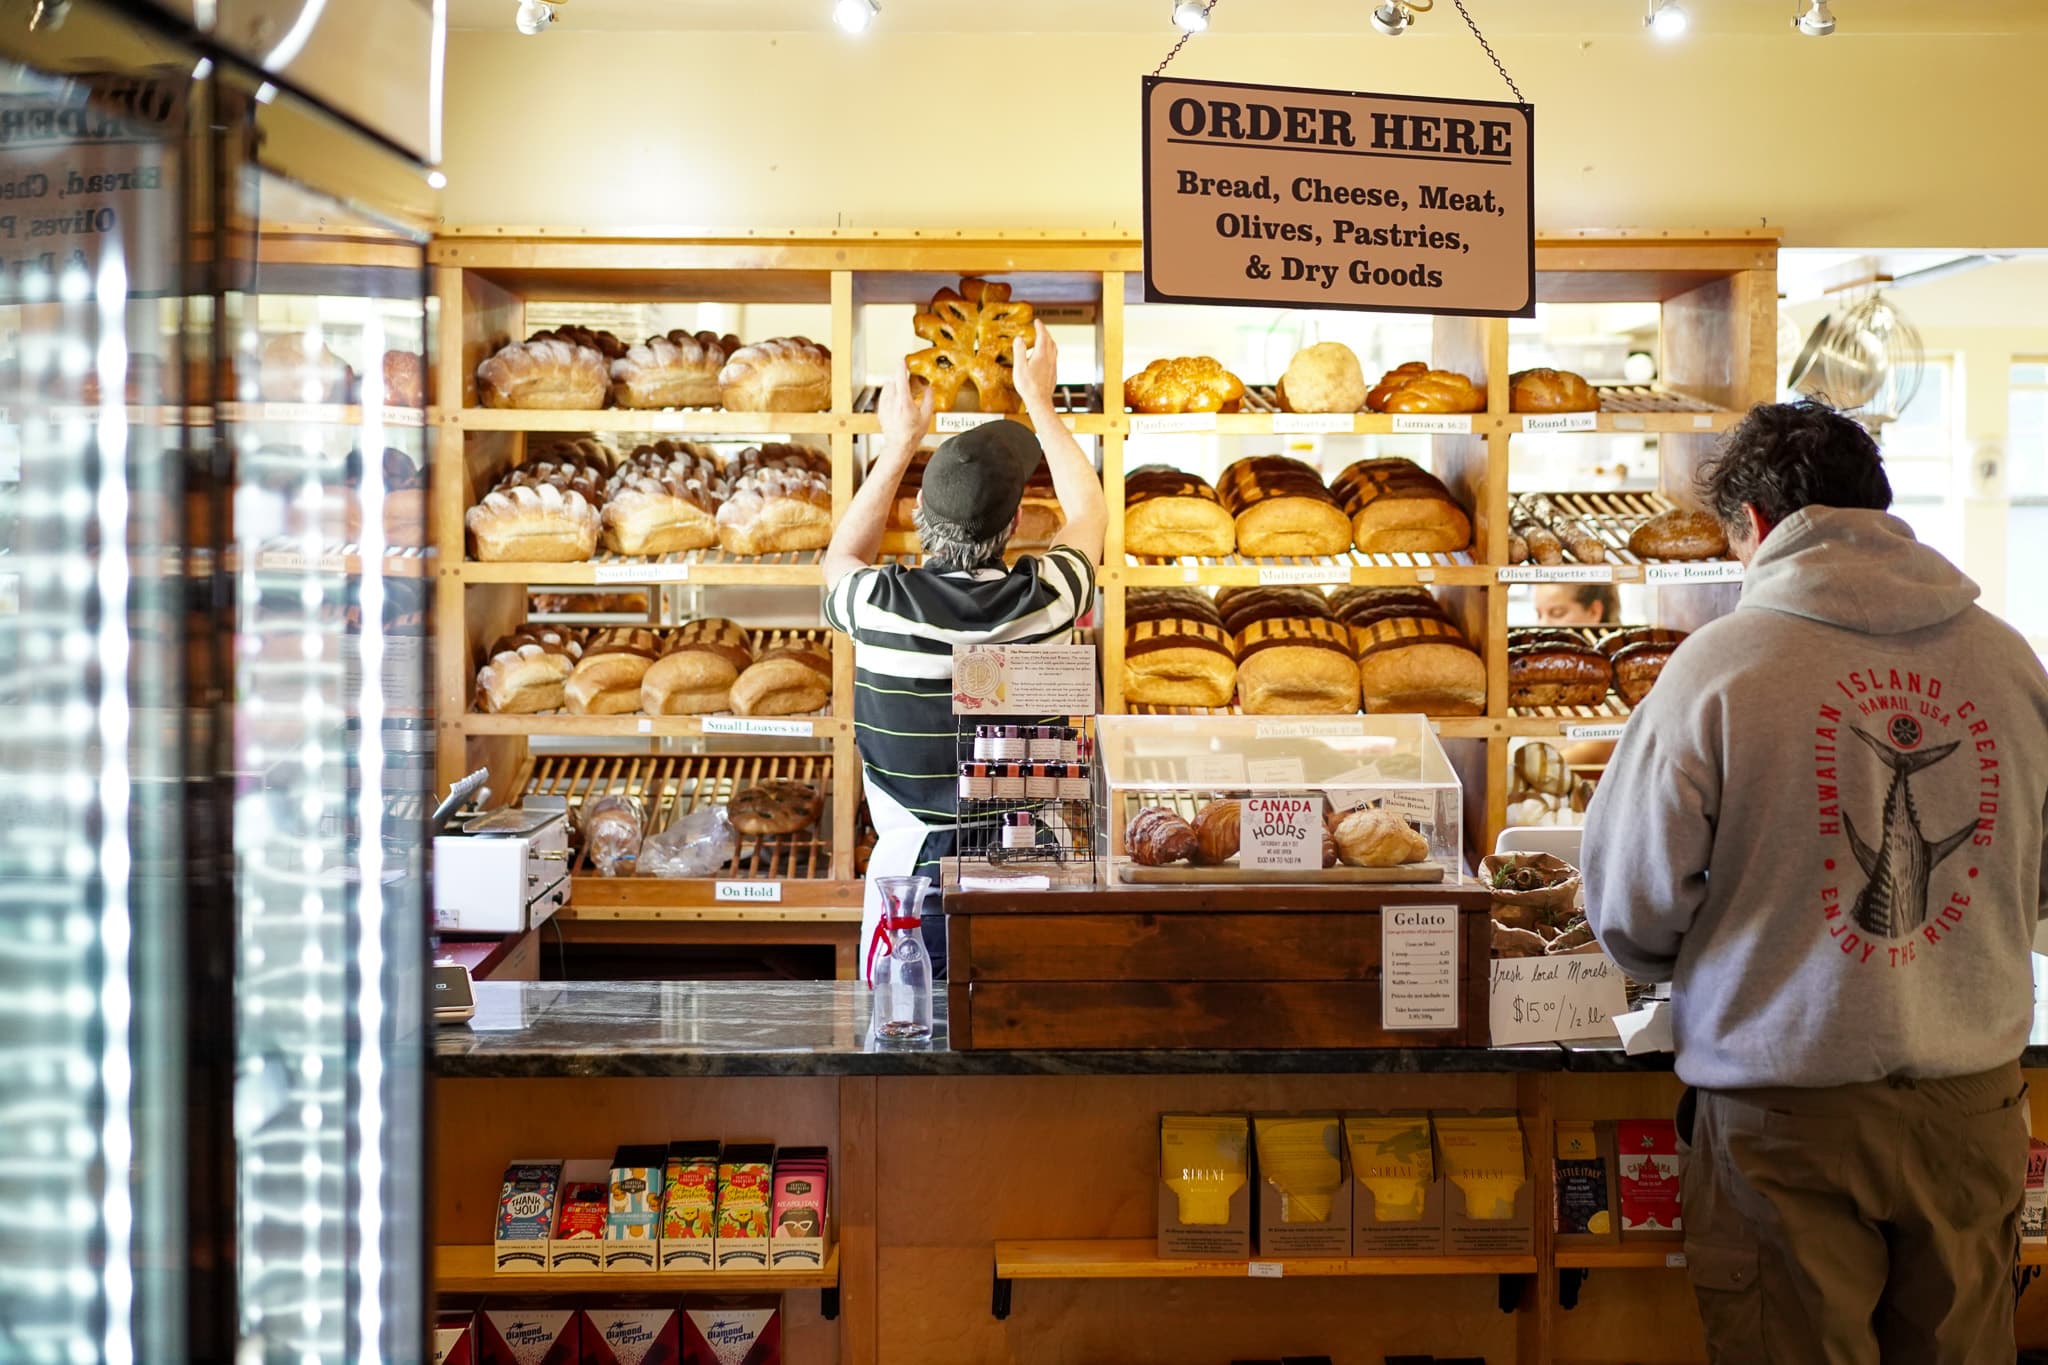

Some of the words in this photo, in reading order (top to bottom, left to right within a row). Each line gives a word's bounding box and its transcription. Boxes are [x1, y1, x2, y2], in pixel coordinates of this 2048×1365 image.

[1169, 98, 1356, 147] ORDER
[1370, 112, 1512, 157] HERE
[1176, 170, 1280, 204] Bread,
[1291, 177, 1408, 211] Cheese,
[1418, 185, 1505, 217] Meat,
[1216, 213, 1322, 246] Olives,
[1333, 220, 1470, 253] Pastries,
[1245, 255, 1271, 279] &
[1281, 257, 1338, 289] Dry
[1349, 260, 1443, 288] Goods
[940, 416, 975, 428] Foglia
[1396, 418, 1444, 429] Lumaca
[1528, 418, 1567, 429] Round
[1500, 567, 1532, 578] Olive
[1535, 567, 1586, 581] Baguette
[1649, 568, 1681, 578] Olive
[1684, 565, 1723, 577] Round
[1920, 700, 1951, 727] USA
[707, 720, 742, 730] Small
[746, 722, 787, 732] Loaves
[1815, 704, 1842, 836] HAWAIIAN
[1836, 668, 1942, 699] ISLAND
[1957, 700, 2000, 847] CREATIONS
[1248, 799, 1312, 812] CANADA
[1264, 812, 1295, 824] DAY
[1252, 823, 1307, 840] HOURS
[722, 886, 740, 897] On
[744, 886, 773, 897] Hold
[1394, 912, 1445, 926] Gelato
[1821, 886, 1875, 964] ENJOY
[1888, 941, 1917, 968] THE
[1924, 891, 1972, 945] RIDE
[1531, 963, 1559, 982] local
[1556, 1167, 1580, 1179] LITTLE
[511, 1196, 542, 1206] THANK
[777, 1199, 819, 1207] NEAPOLITAN
[514, 1204, 540, 1216] YOU!
[506, 1325, 542, 1340] Diamond
[522, 1332, 553, 1345] Crystal
[606, 1325, 642, 1339] Diamond
[622, 1331, 653, 1345] Crystal
[707, 1325, 743, 1339] Diamond
[723, 1331, 754, 1345] Crystal
